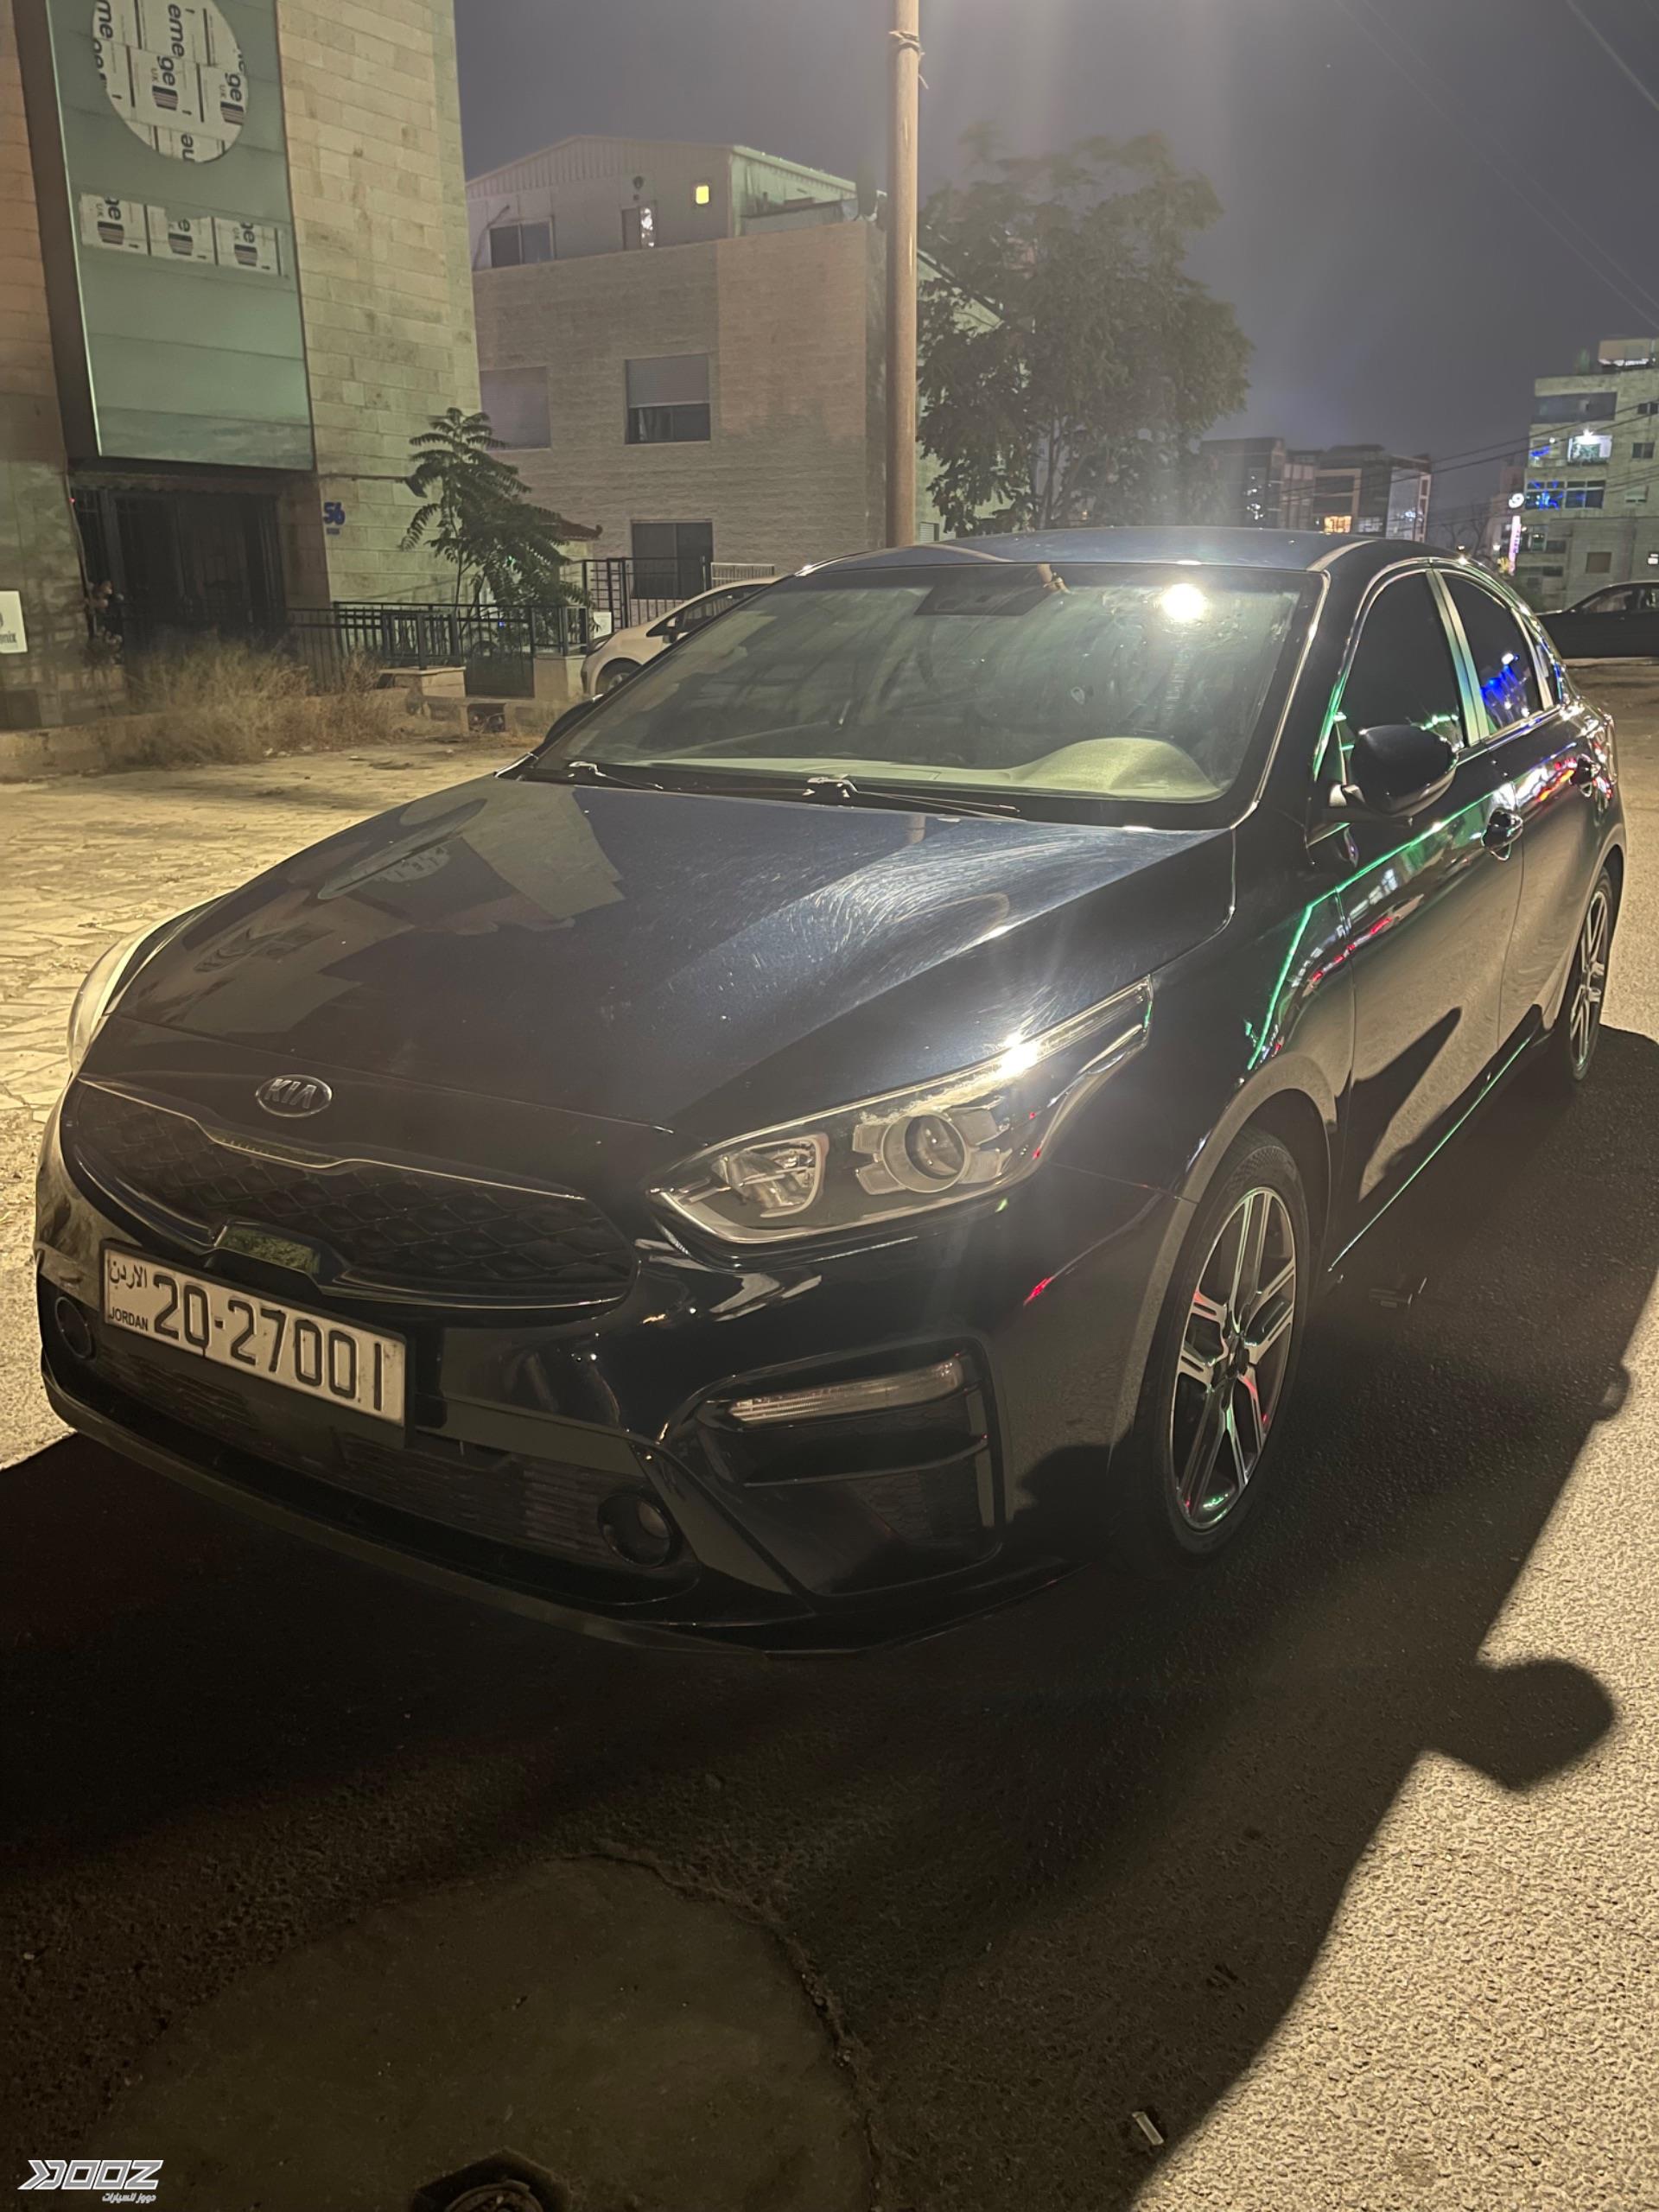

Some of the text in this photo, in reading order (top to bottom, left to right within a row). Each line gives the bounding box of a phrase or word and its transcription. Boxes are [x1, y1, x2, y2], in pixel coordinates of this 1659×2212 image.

[156, 56, 176, 86] ge
[225, 73, 243, 102] ge
[264, 1078, 317, 1109] KIA
[109, 1306, 149, 1332] JORDAN
[152, 1274, 383, 1412] 20-27001
